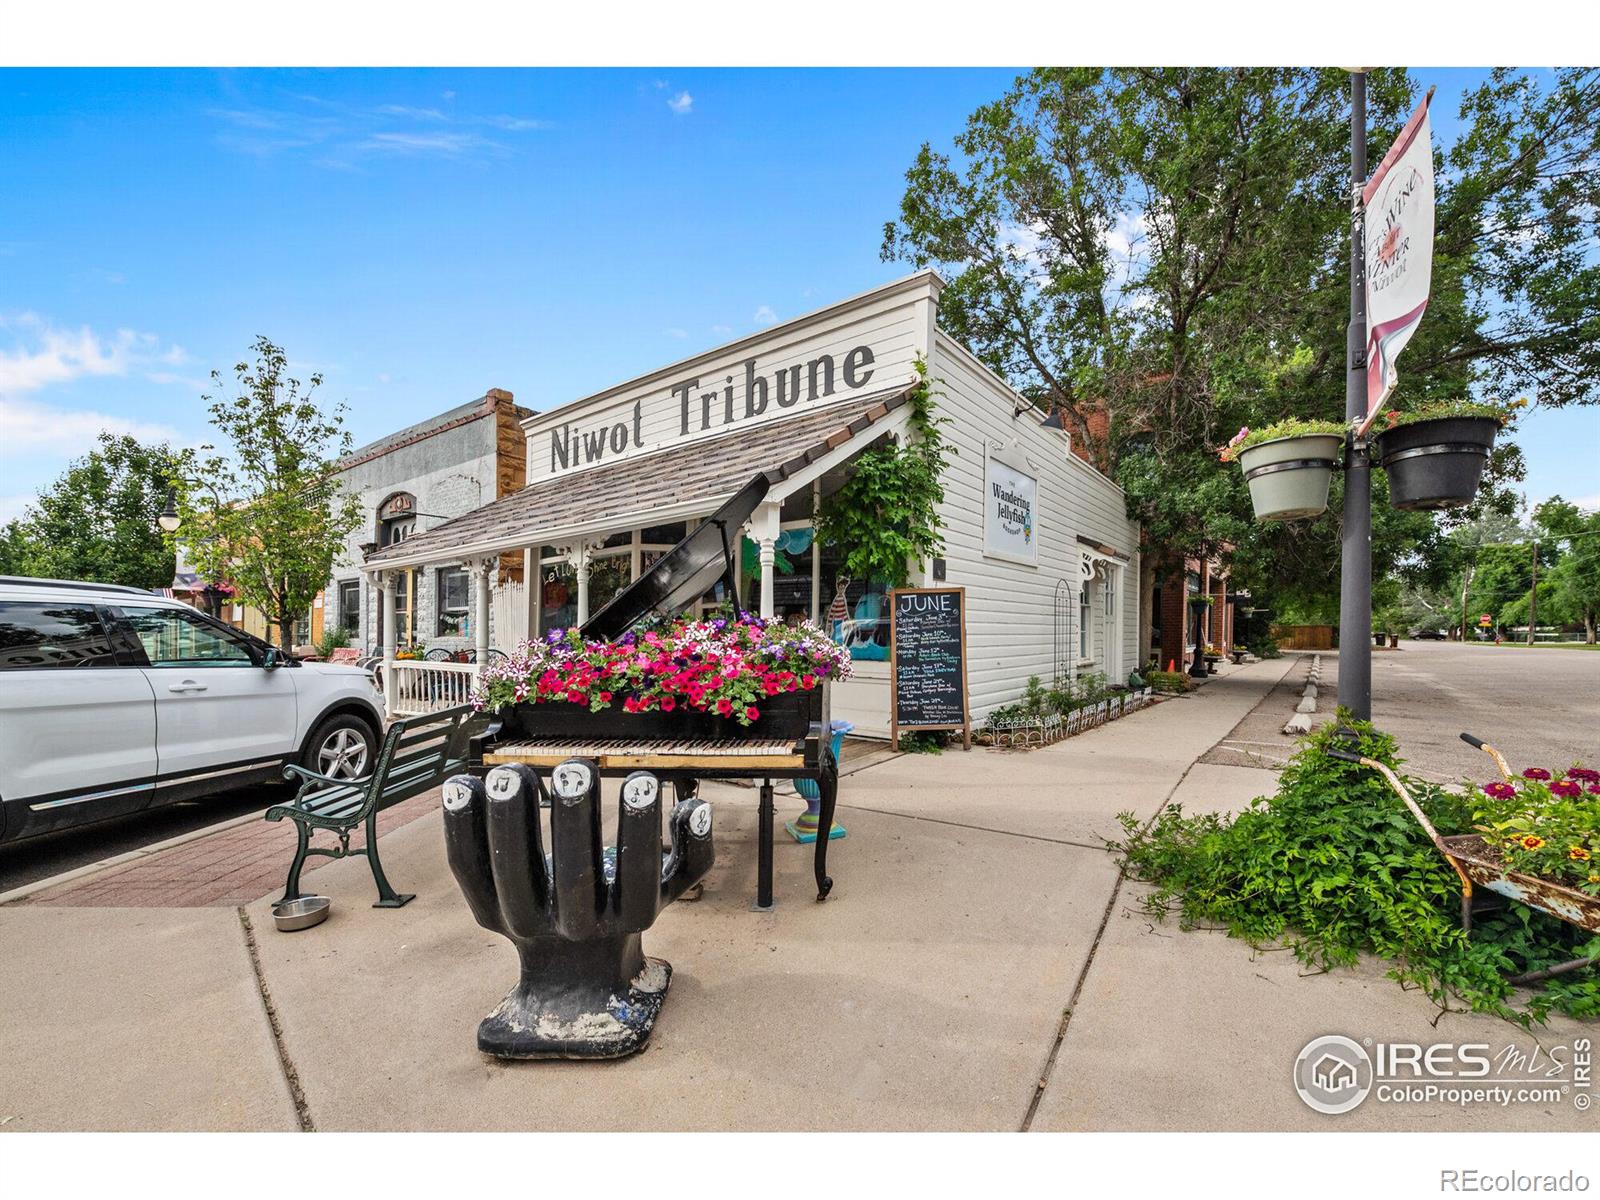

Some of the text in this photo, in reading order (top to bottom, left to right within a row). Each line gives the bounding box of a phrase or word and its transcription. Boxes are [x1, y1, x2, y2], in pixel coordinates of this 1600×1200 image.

[551, 344, 876, 473] Niwot Tribune
[992, 482, 1030, 515] Wandering
[997, 502, 1025, 525] Jellyfish
[900, 594, 952, 613] JUNE
